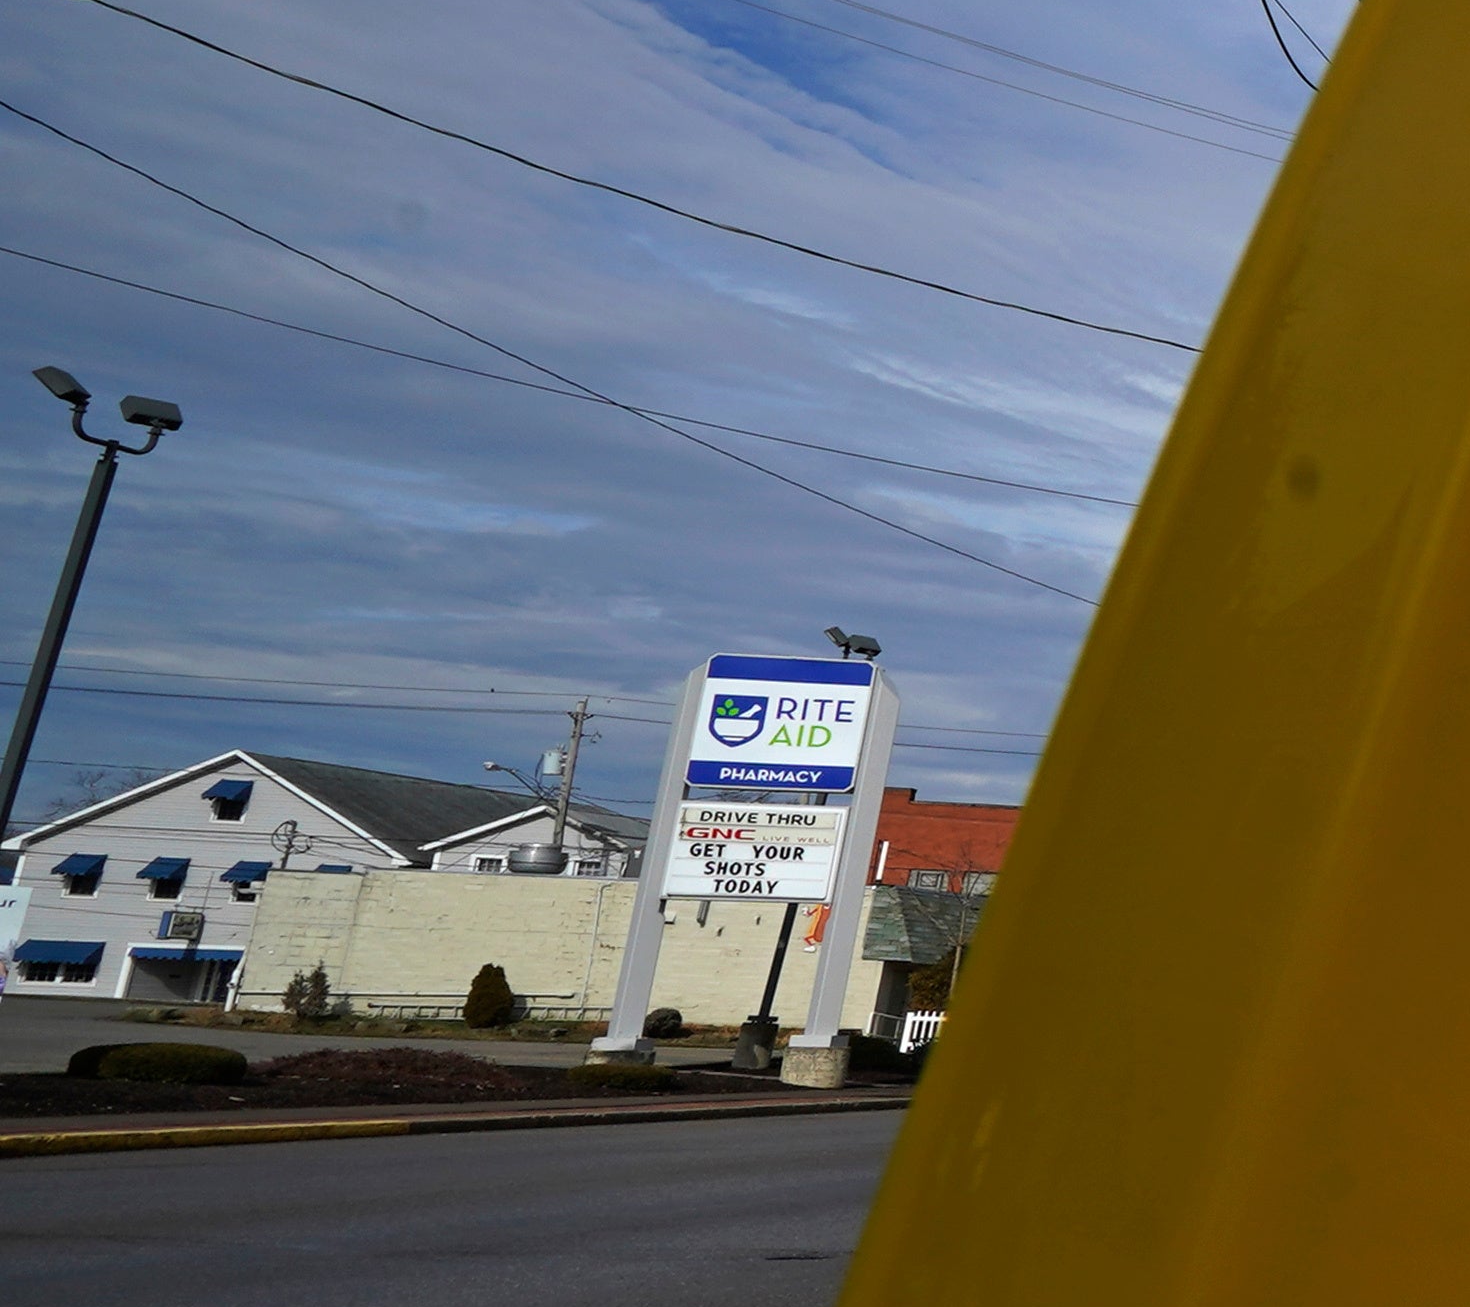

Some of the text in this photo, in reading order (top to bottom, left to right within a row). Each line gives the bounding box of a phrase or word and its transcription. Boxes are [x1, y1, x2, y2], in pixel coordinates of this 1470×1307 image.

[776, 697, 856, 723] RITE
[768, 724, 832, 747] AID
[719, 767, 822, 783] PHARMACY
[700, 810, 817, 826] DRIVE THRU
[686, 827, 757, 841] GNC
[690, 843, 805, 861] GET YOUR
[704, 861, 766, 877] SHOTS
[714, 879, 779, 895] TODAY
